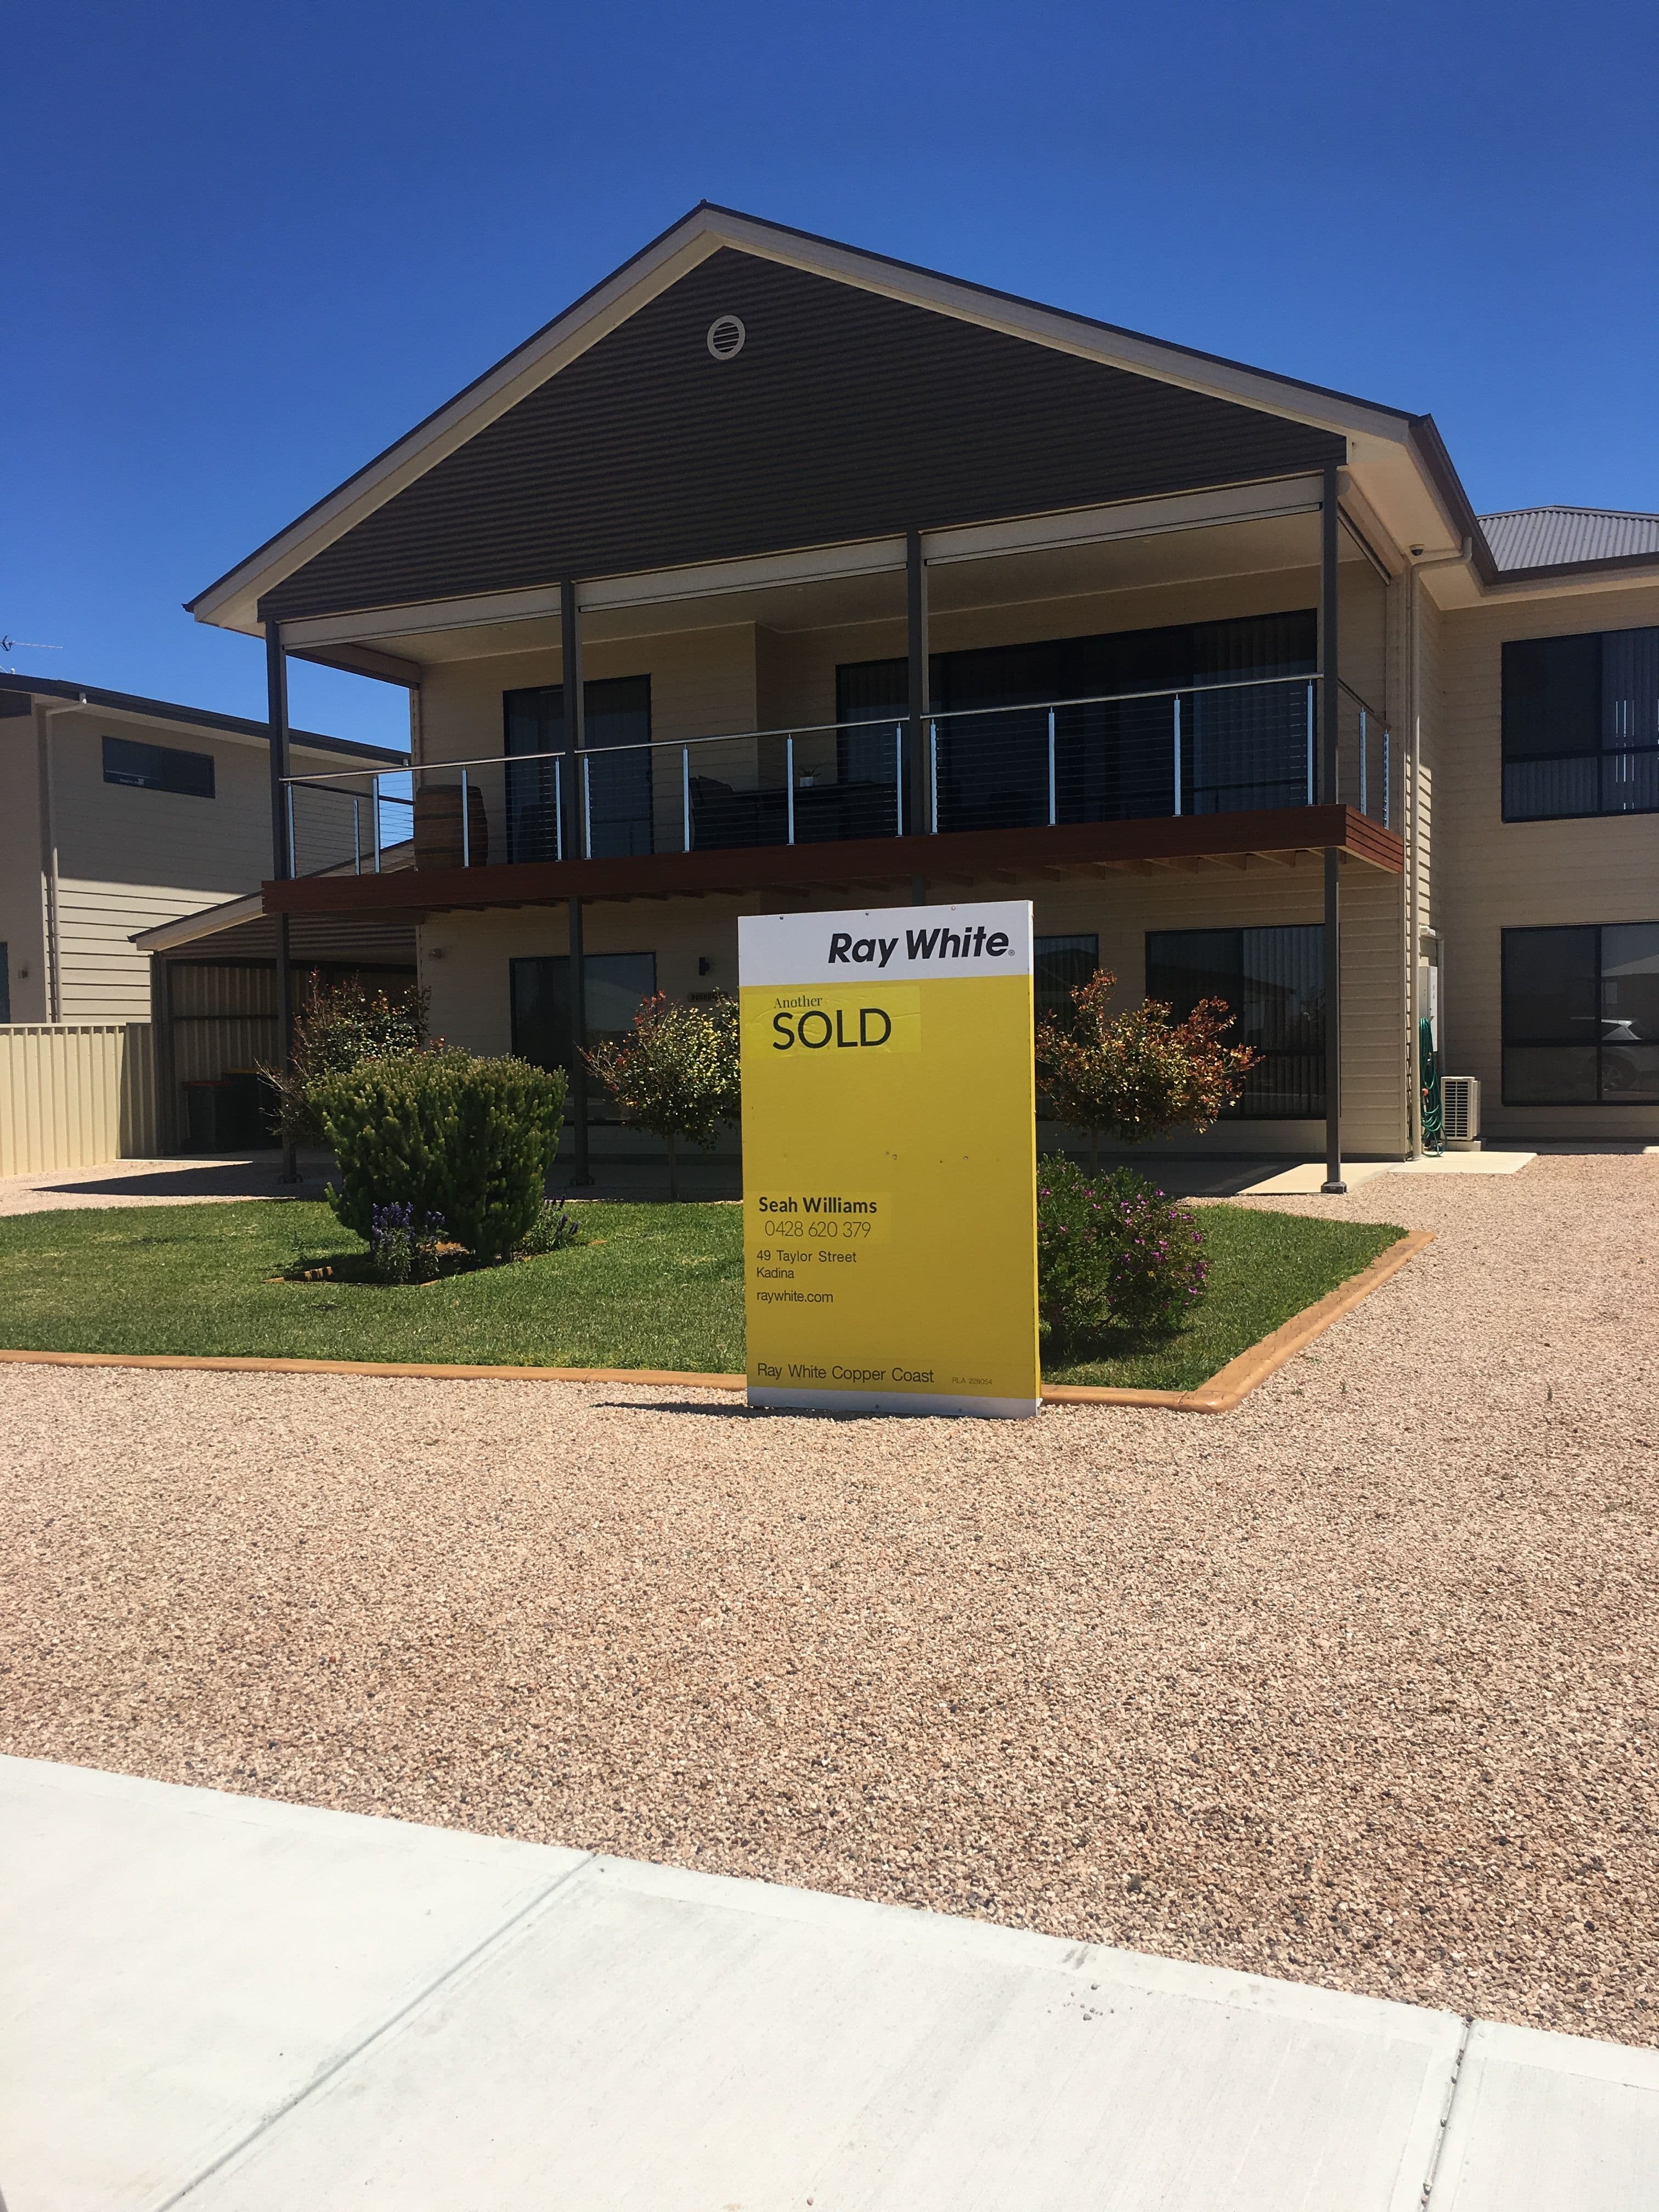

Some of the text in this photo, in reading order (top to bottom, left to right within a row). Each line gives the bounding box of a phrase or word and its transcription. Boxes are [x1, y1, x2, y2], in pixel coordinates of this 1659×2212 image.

[828, 933, 899, 968] Ray
[774, 995, 823, 1009] Another
[772, 1008, 891, 1050] SOLD
[759, 1197, 877, 1214] Seah Williams
[765, 1220, 871, 1238] 0428 620 379
[756, 1250, 857, 1265] 49 Taylor Street
[757, 1266, 795, 1279] Kadina
[757, 1290, 833, 1304] raywhite.com
[758, 1363, 934, 1384] Ray White Copper Coast
